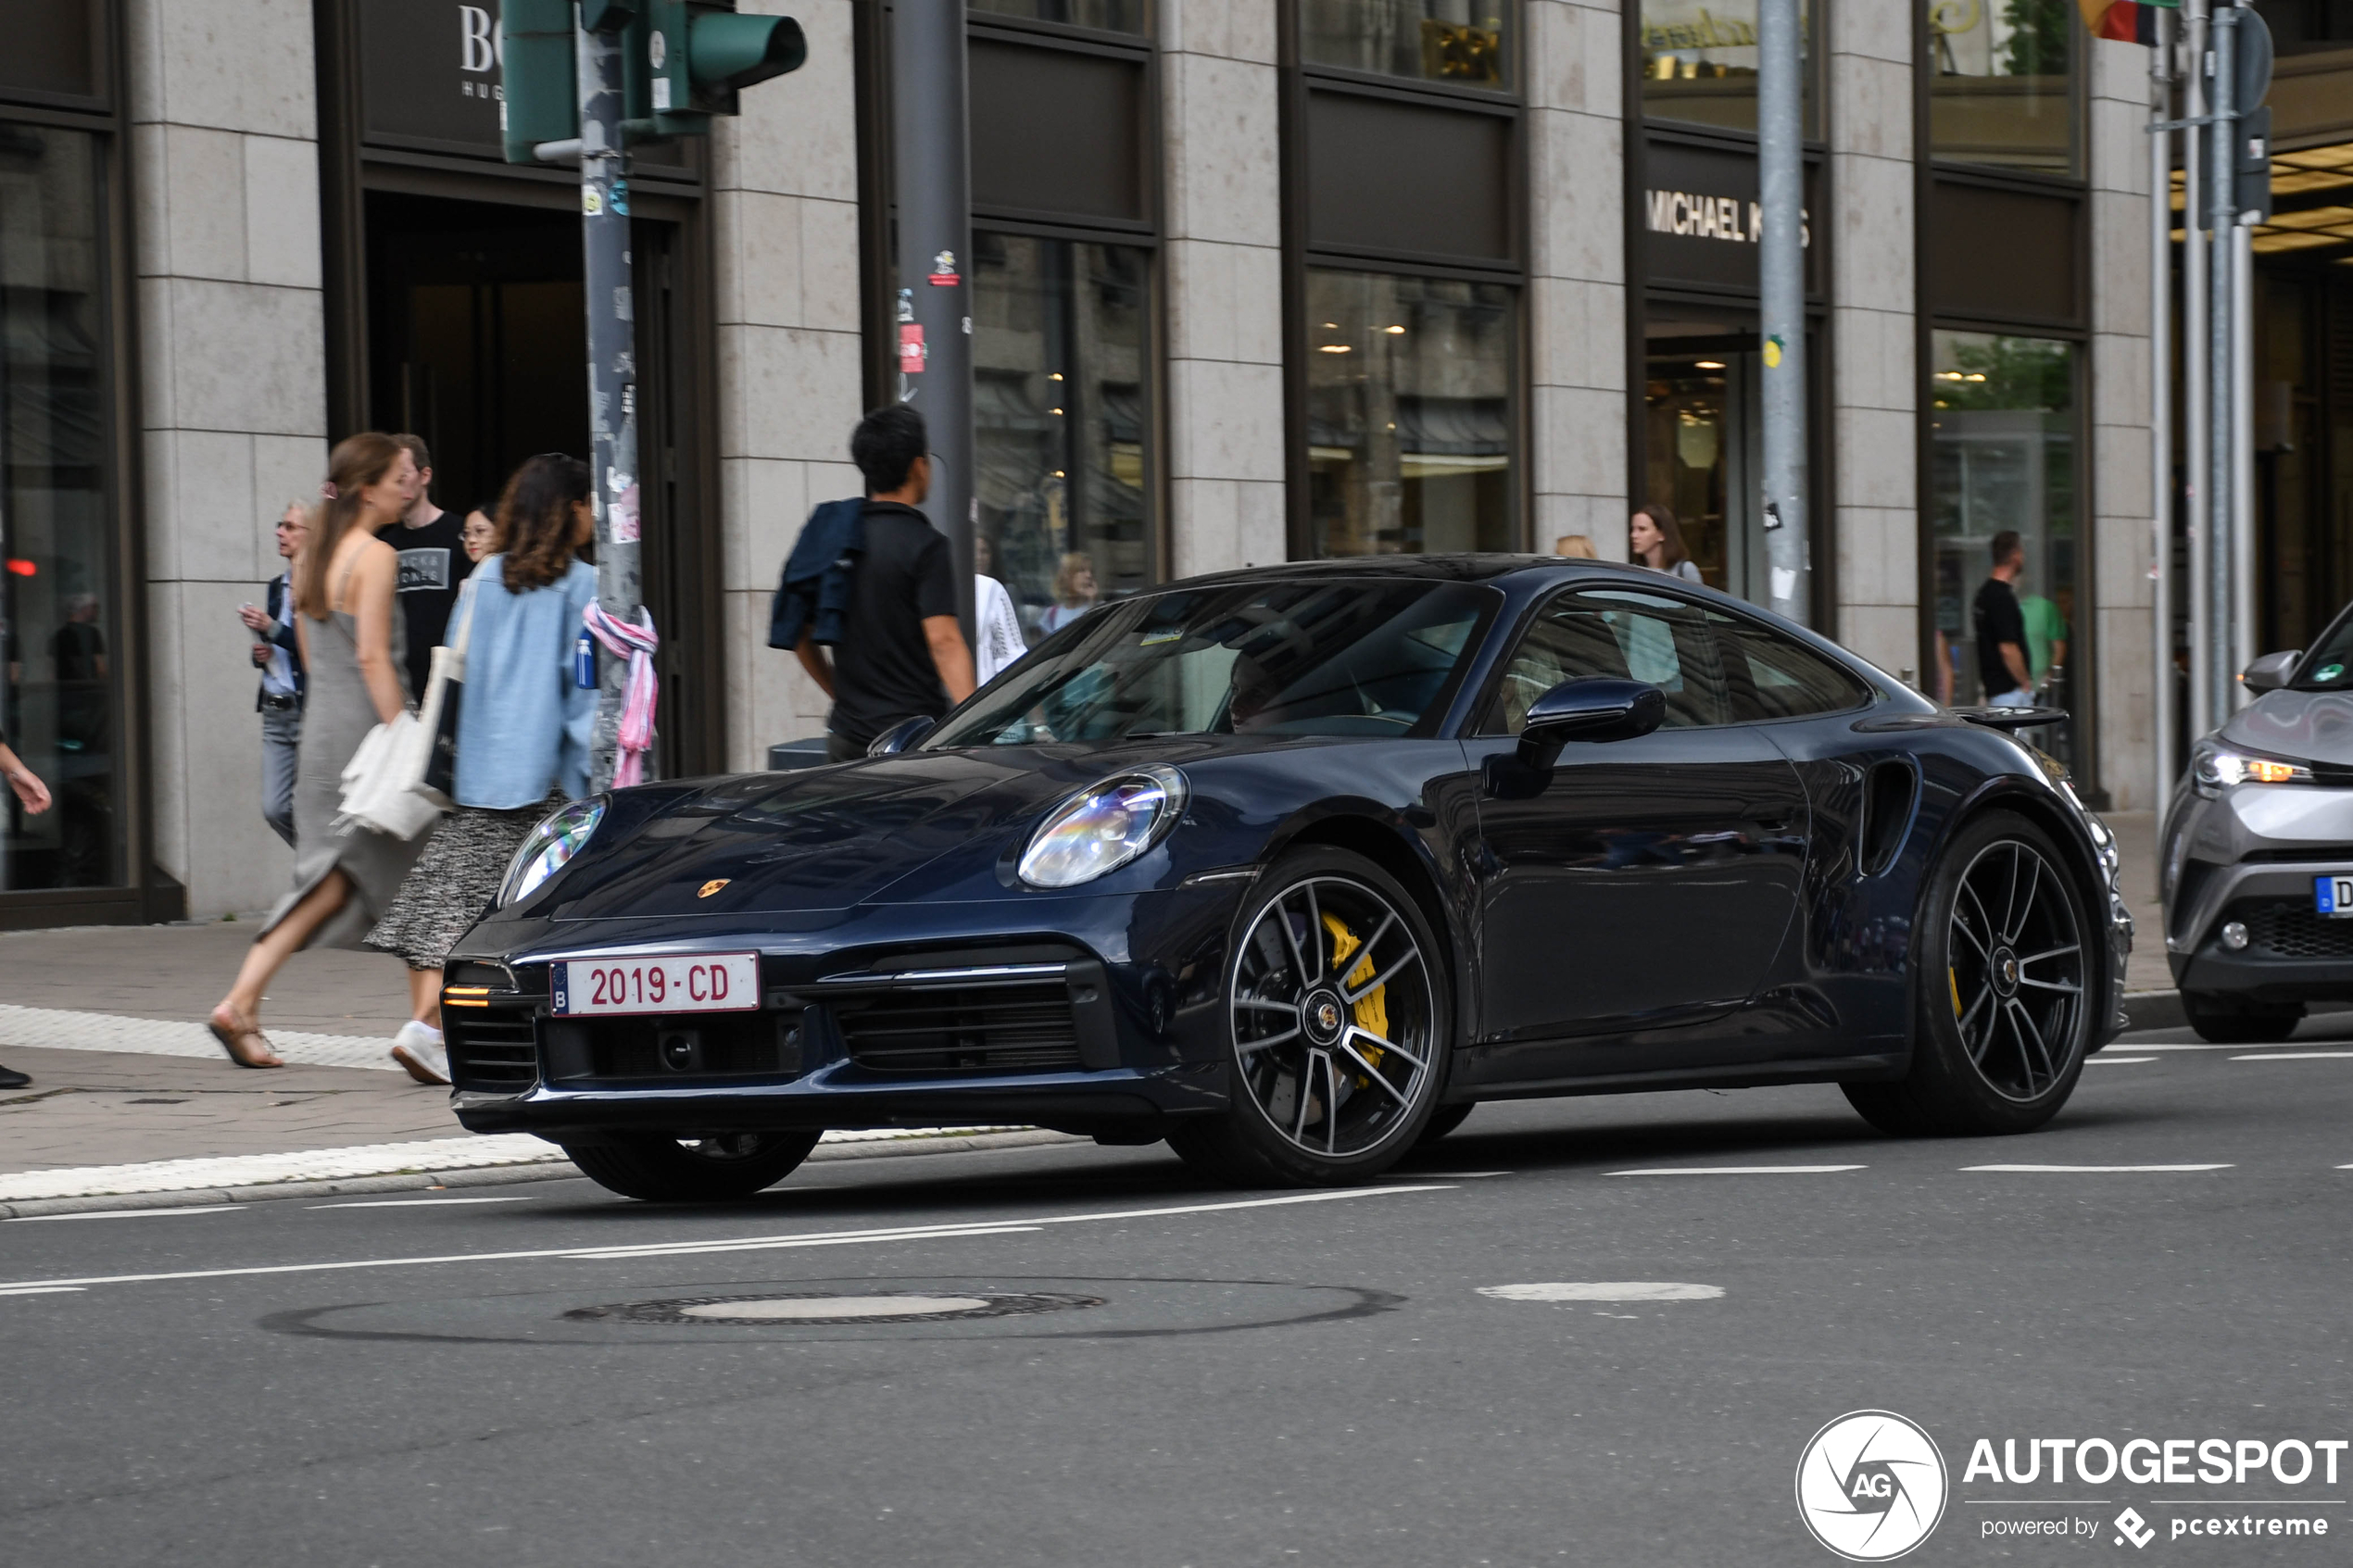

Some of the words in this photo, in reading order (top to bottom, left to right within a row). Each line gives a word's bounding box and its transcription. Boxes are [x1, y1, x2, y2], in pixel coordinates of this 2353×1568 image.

[1644, 189, 1745, 242] MICHAEL
[555, 991, 566, 1008] B
[591, 964, 728, 1006] 2019-CD
